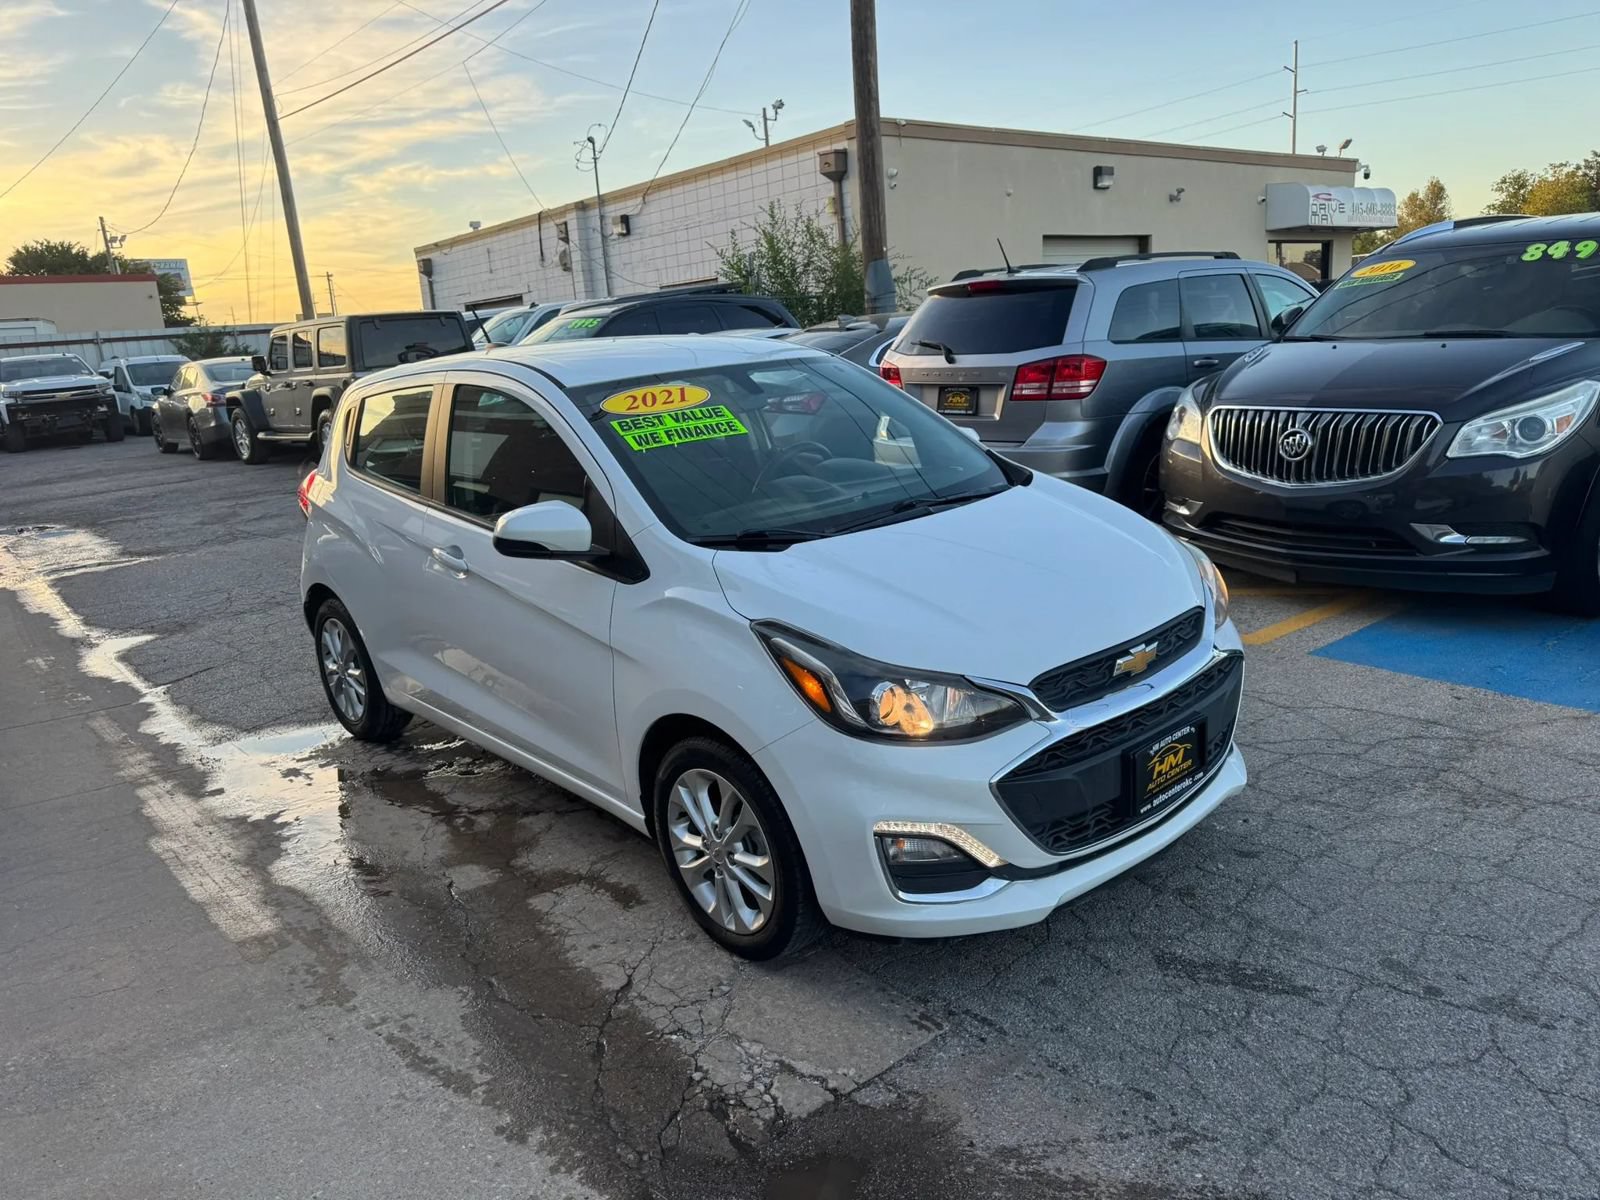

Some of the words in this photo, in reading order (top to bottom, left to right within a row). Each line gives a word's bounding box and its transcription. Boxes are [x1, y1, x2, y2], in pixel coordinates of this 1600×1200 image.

[1310, 203, 1346, 214] DRIVE
[624, 387, 690, 411] 2021
[616, 415, 666, 433] BEST
[669, 406, 726, 424] VALUE
[631, 431, 662, 448] WE
[664, 420, 739, 442] FINANCE
[1160, 735, 1172, 749] AUTO
[1172, 726, 1191, 741] CENTER
[1146, 774, 1167, 793] AUTO
[1167, 758, 1193, 781] CENTER
[1153, 747, 1186, 780] HM
